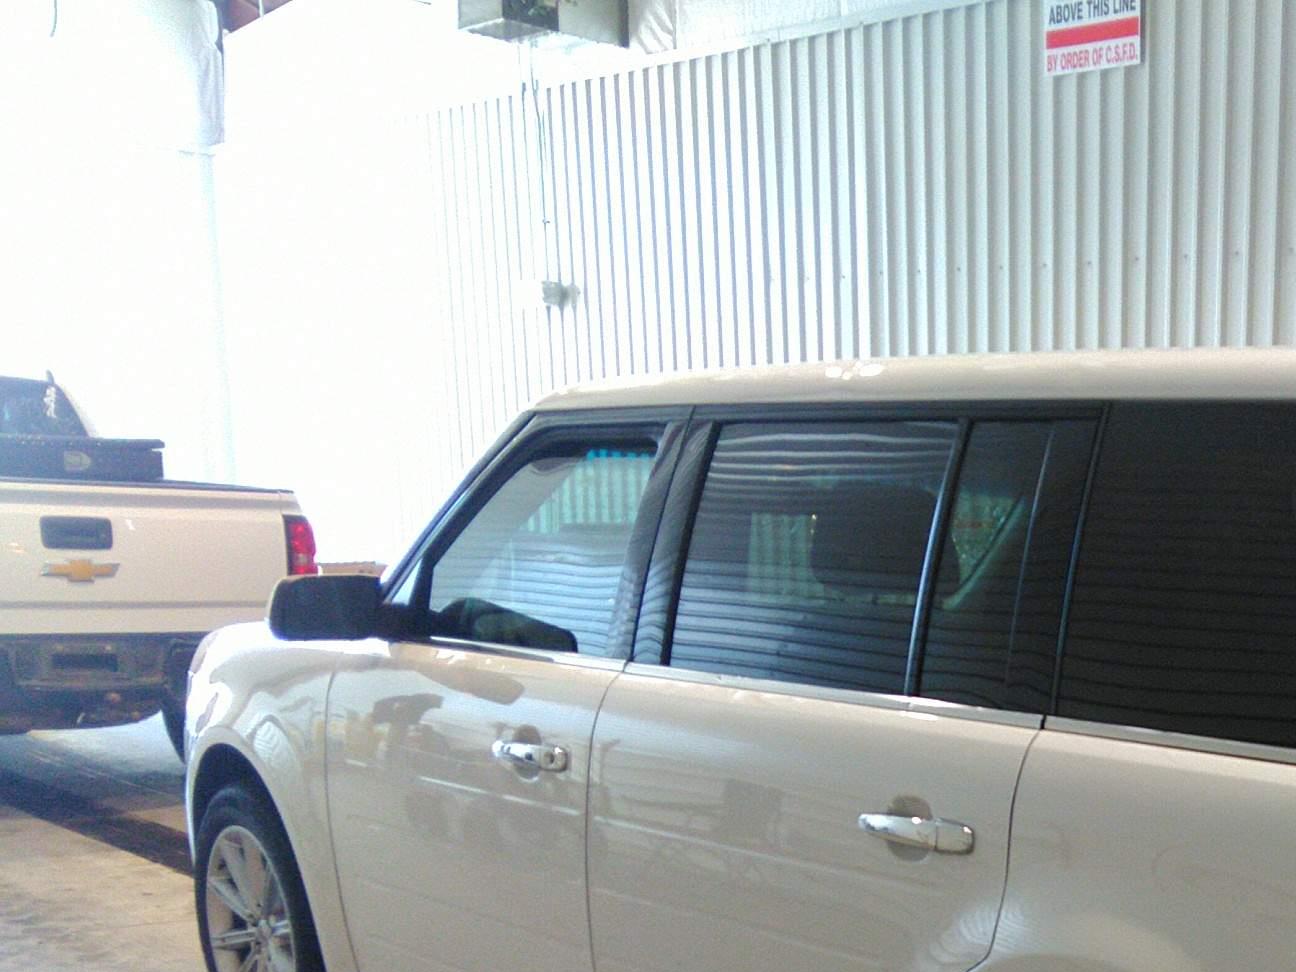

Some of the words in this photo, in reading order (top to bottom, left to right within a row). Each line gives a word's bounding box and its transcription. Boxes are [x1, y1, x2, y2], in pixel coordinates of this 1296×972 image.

[1048, 2, 1084, 25] ABOVE
[1087, 0, 1110, 18] THIS
[1113, 0, 1136, 14] LINE
[1047, 54, 1058, 72] BY
[1060, 49, 1090, 70] ORDER
[1092, 47, 1104, 66] OF
[1106, 42, 1138, 63] C.S.F.D.
